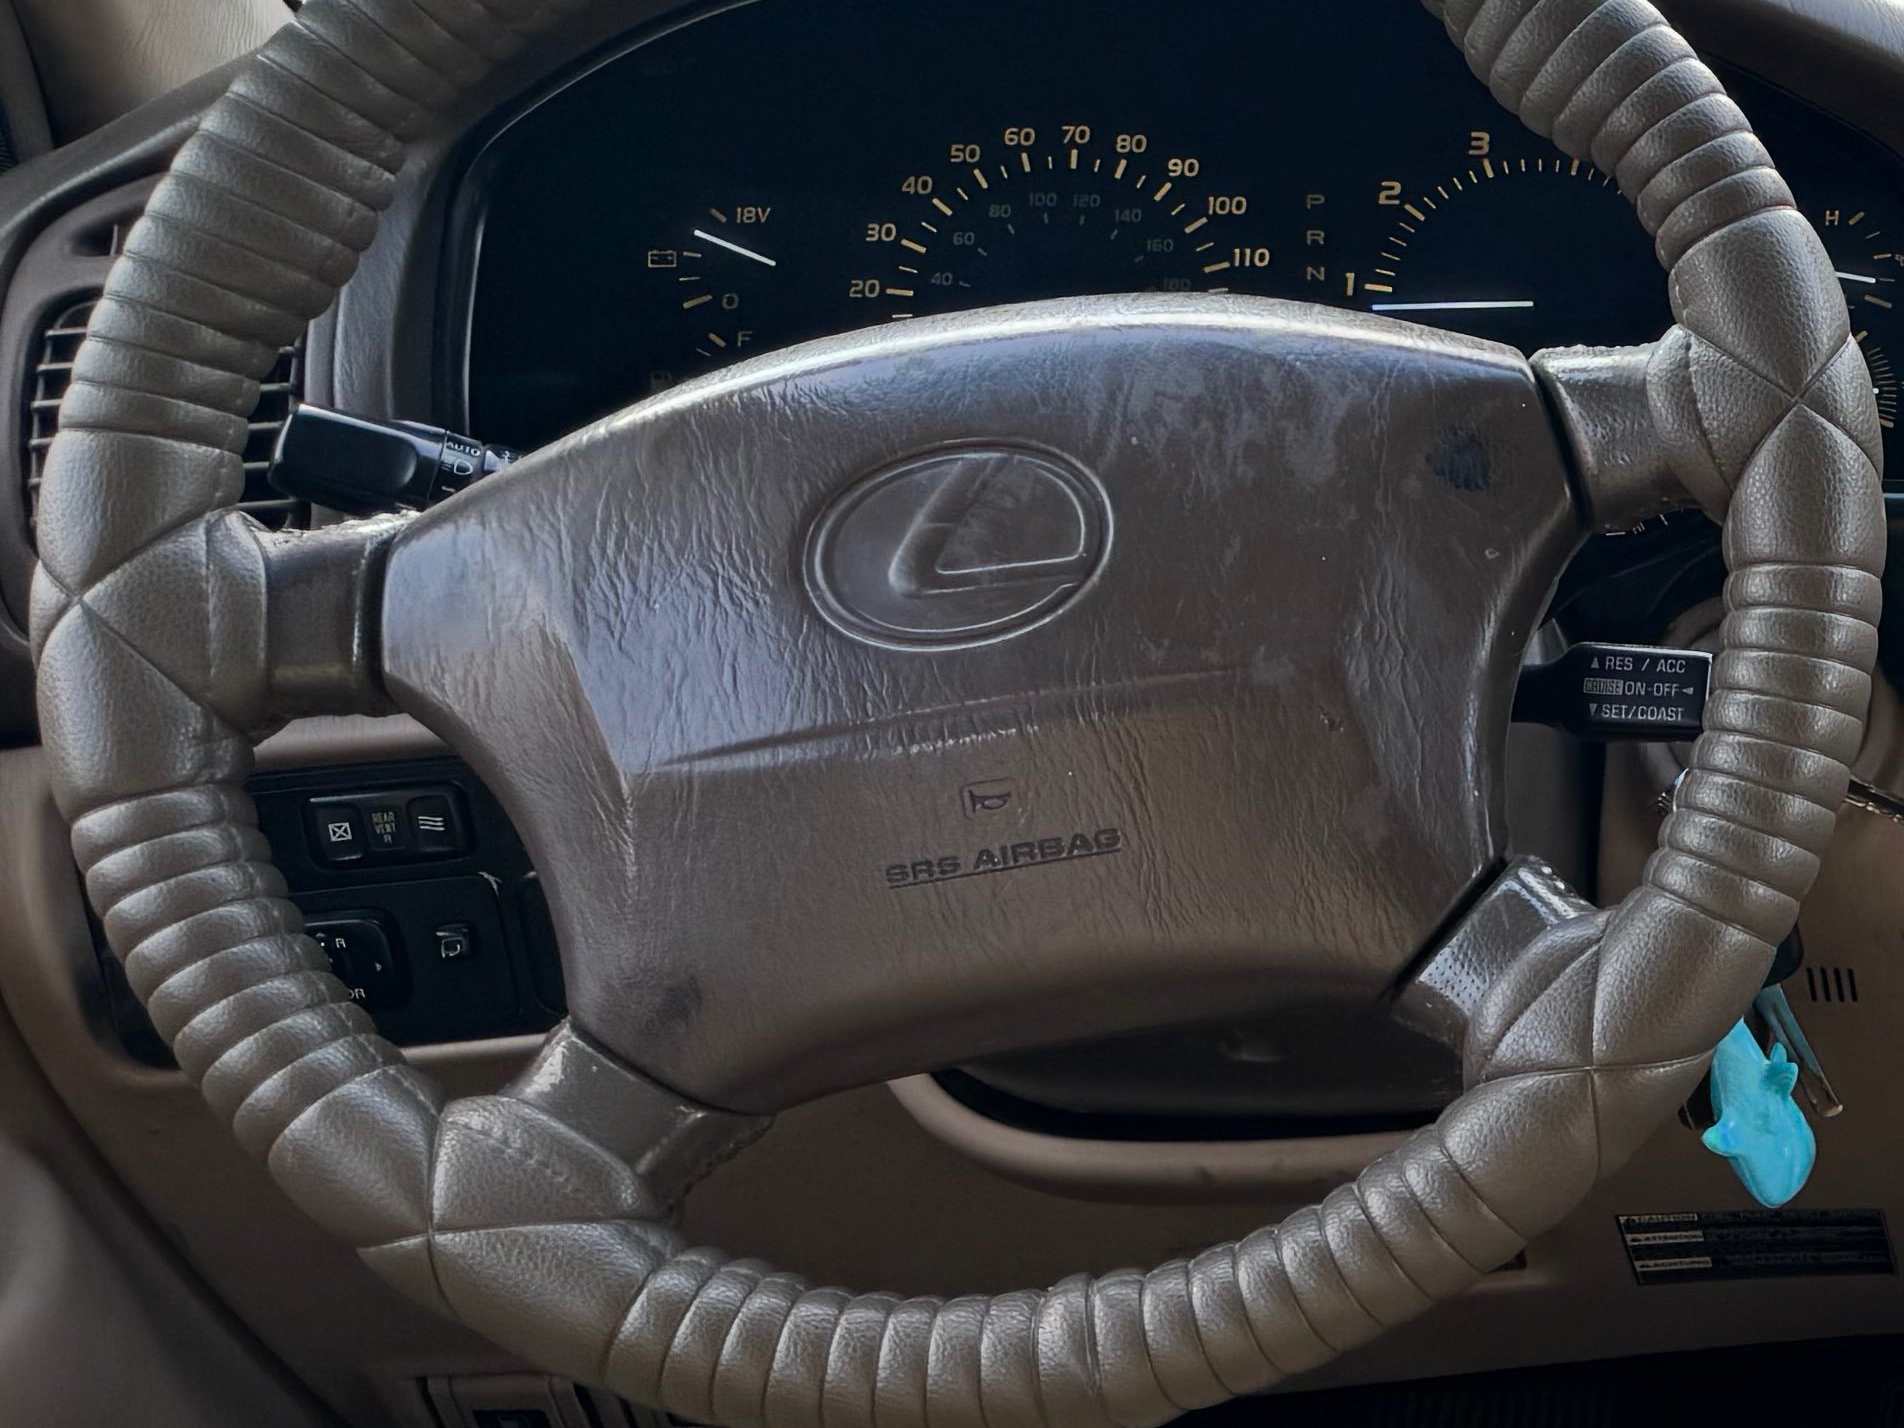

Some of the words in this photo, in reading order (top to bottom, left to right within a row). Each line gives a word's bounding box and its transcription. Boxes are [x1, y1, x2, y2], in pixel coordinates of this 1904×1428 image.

[1003, 126, 1037, 146] 60
[1061, 124, 1091, 145] 70
[1115, 133, 1148, 153] 80
[1468, 130, 1490, 155] 3
[949, 143, 982, 164] 50
[1167, 157, 1200, 178] 90
[901, 175, 934, 195] 40
[1377, 180, 1402, 205] 2
[1029, 192, 1057, 207] 100
[1072, 194, 1100, 208] 120
[1207, 195, 1248, 215] 100
[1306, 194, 1326, 209] P
[735, 206, 771, 224] 18V
[988, 204, 1012, 219] 80
[1114, 208, 1142, 223] 140
[1825, 209, 1840, 226] H
[865, 222, 897, 243] 30
[953, 231, 975, 246] 60
[1306, 230, 1325, 246] R
[1146, 238, 1175, 253] 160
[1232, 247, 1271, 267] 110
[930, 272, 954, 287] 40
[1306, 265, 1326, 282] N
[848, 278, 881, 299] 20
[1345, 272, 1356, 296] 1
[446, 440, 481, 457] AUTO
[1605, 656, 1633, 671] RES
[1656, 659, 1686, 673] ACC
[1625, 681, 1680, 697] ON-OFF
[1601, 703, 1685, 721] SET/COAST
[886, 854, 962, 884] SRS
[973, 827, 1122, 870] AIRBAG
[335, 937, 347, 949] R
